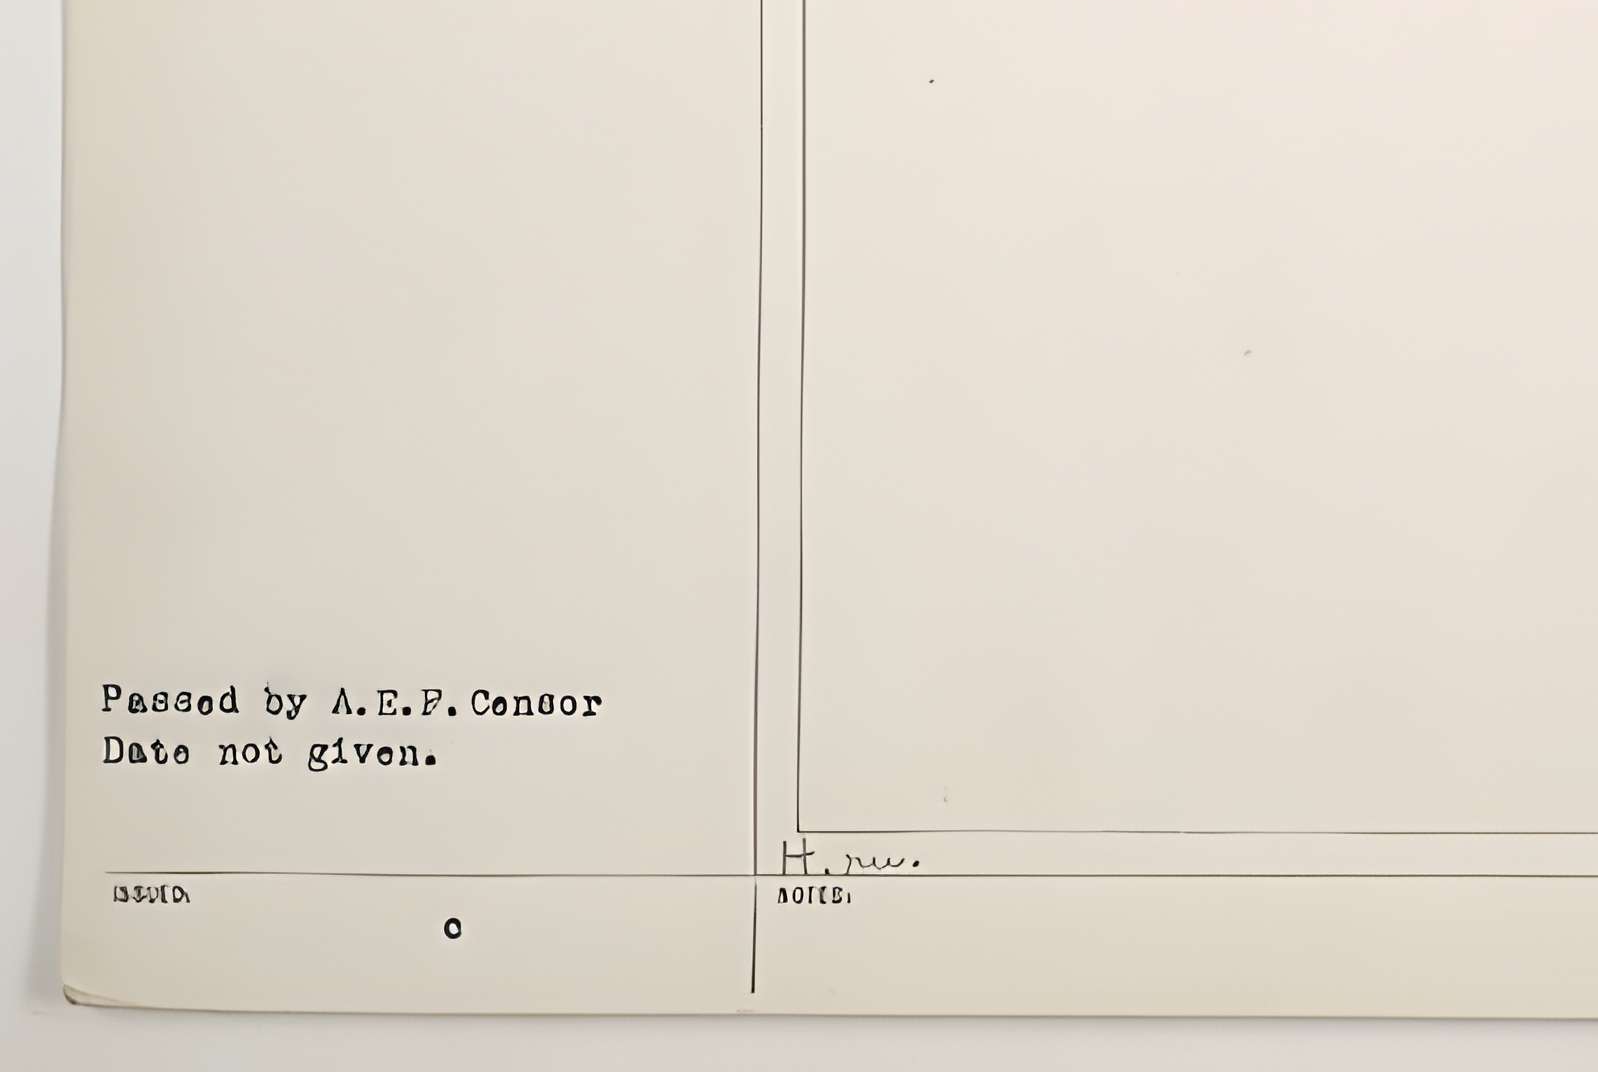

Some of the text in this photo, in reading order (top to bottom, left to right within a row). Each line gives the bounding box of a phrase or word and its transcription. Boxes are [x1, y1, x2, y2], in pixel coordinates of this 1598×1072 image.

[101, 683, 240, 716] Passed
[263, 681, 308, 721] by
[102, 735, 438, 773] Date not given.
